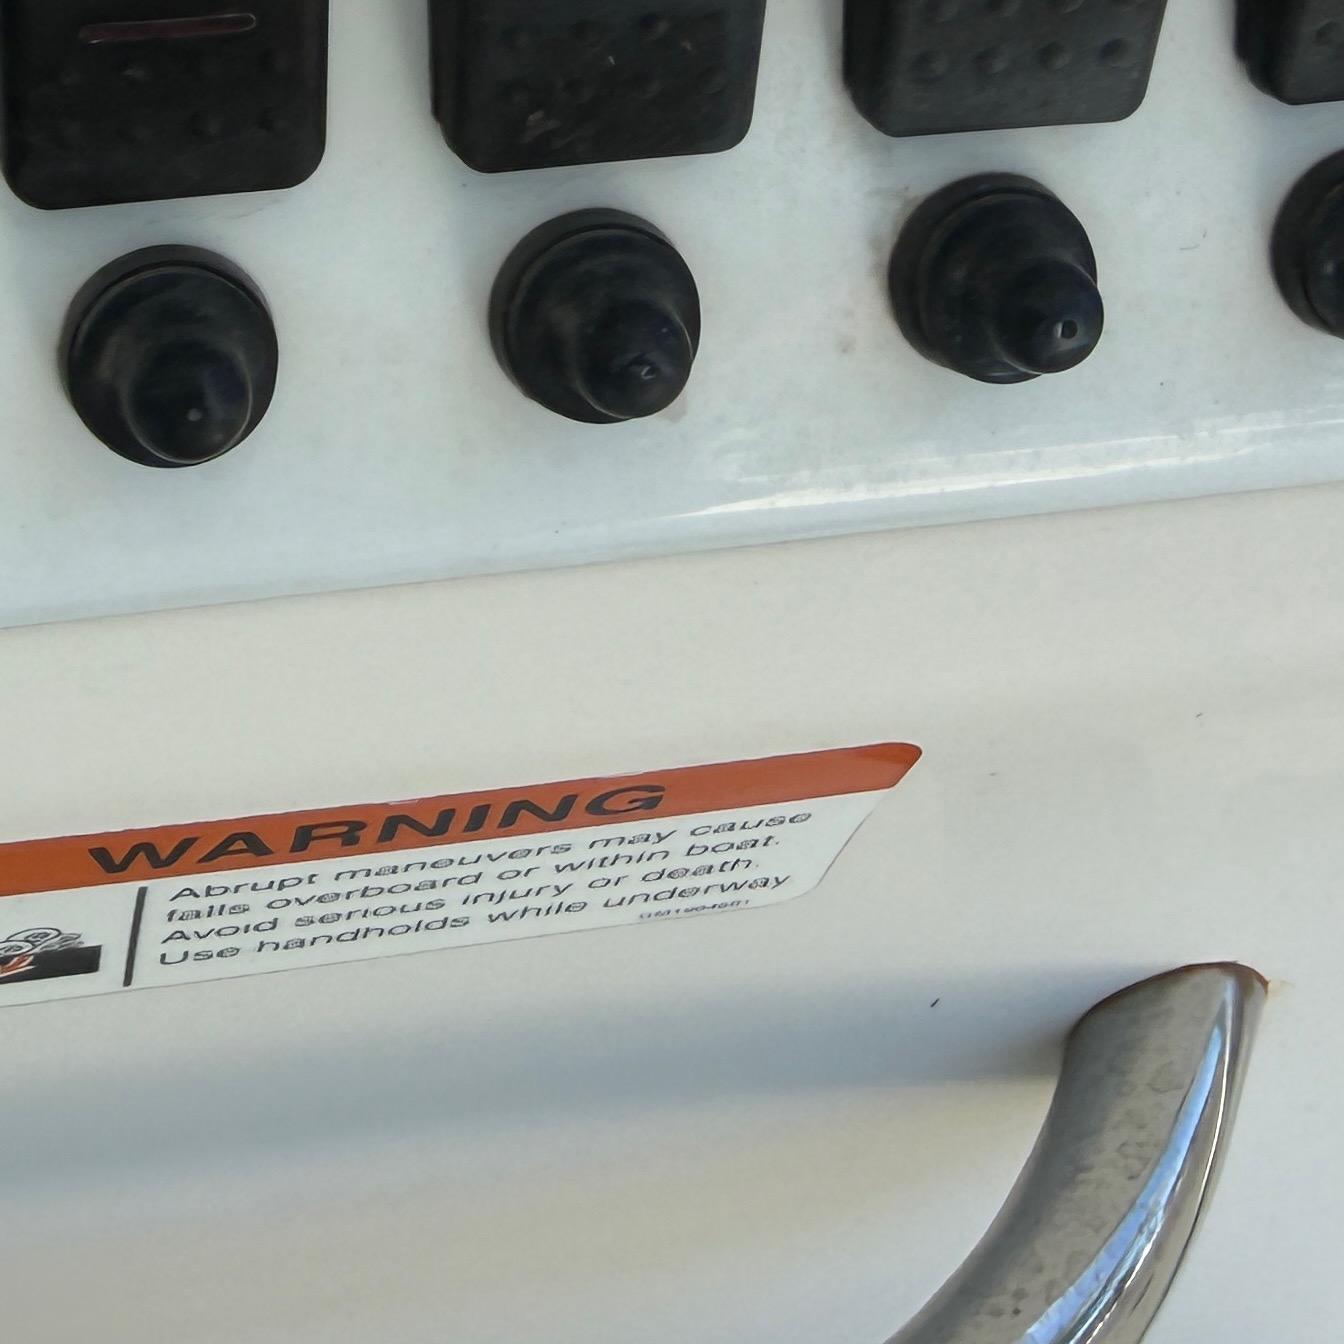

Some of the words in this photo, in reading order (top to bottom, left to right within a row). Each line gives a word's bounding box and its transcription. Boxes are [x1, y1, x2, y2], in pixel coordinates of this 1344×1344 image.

[88, 784, 666, 877] WARNING
[169, 873, 318, 902] Abrupt
[334, 841, 572, 882] maneuvers
[589, 829, 678, 850] may
[689, 812, 812, 837] cause
[159, 946, 242, 966] Use
[256, 914, 472, 953] handholds
[487, 900, 588, 924] while
[602, 873, 792, 909] underway
[160, 918, 279, 944] Avoid
[294, 898, 447, 927] serious
[462, 882, 574, 906] injury
[587, 874, 630, 890] or
[166, 903, 250, 922] falls
[266, 871, 484, 910] overboard
[496, 866, 540, 881] or
[553, 849, 670, 874] within
[684, 835, 780, 857] boat.
